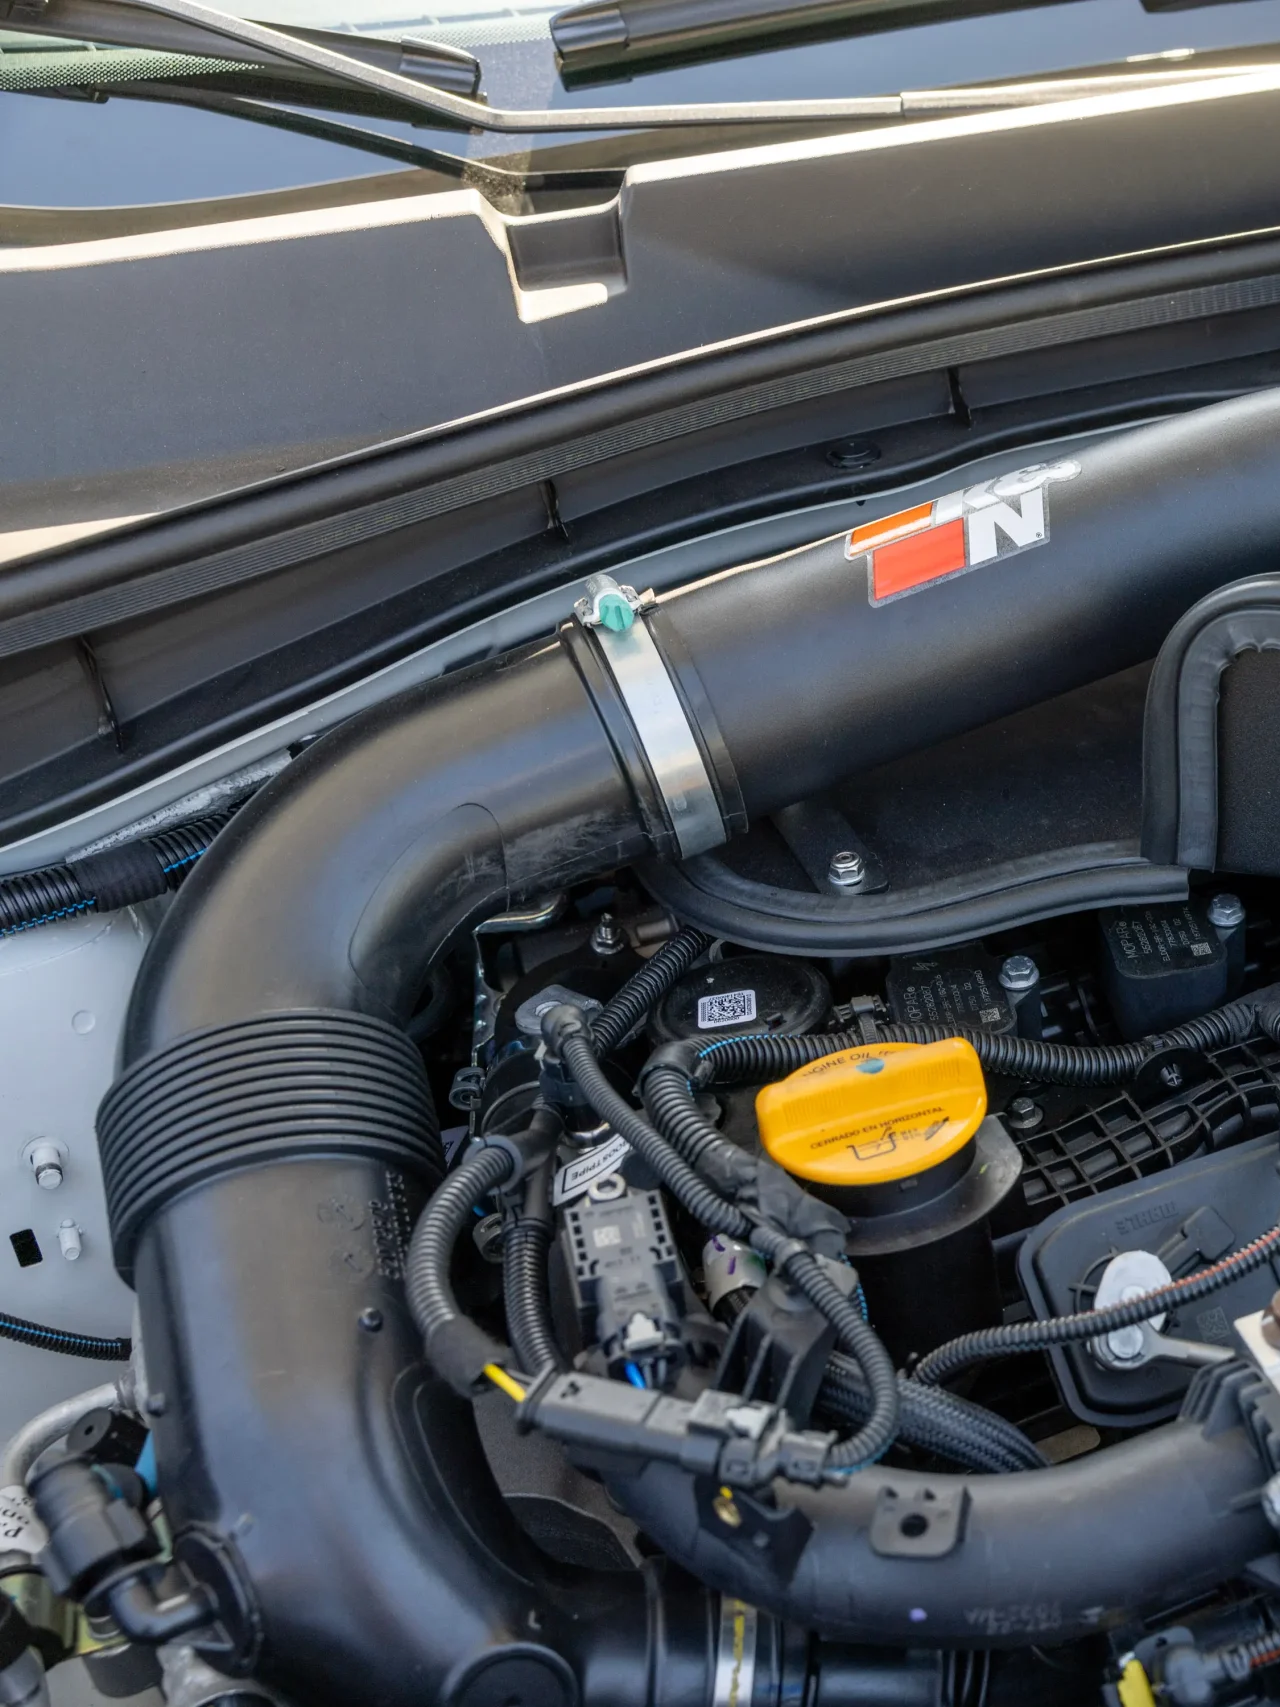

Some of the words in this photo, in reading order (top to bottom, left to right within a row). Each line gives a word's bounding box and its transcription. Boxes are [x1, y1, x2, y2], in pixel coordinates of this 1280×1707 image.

[809, 1129, 860, 1150] CERRADO
[862, 1122, 879, 1133] EN
[880, 1105, 945, 1128] HORIZONTAL
